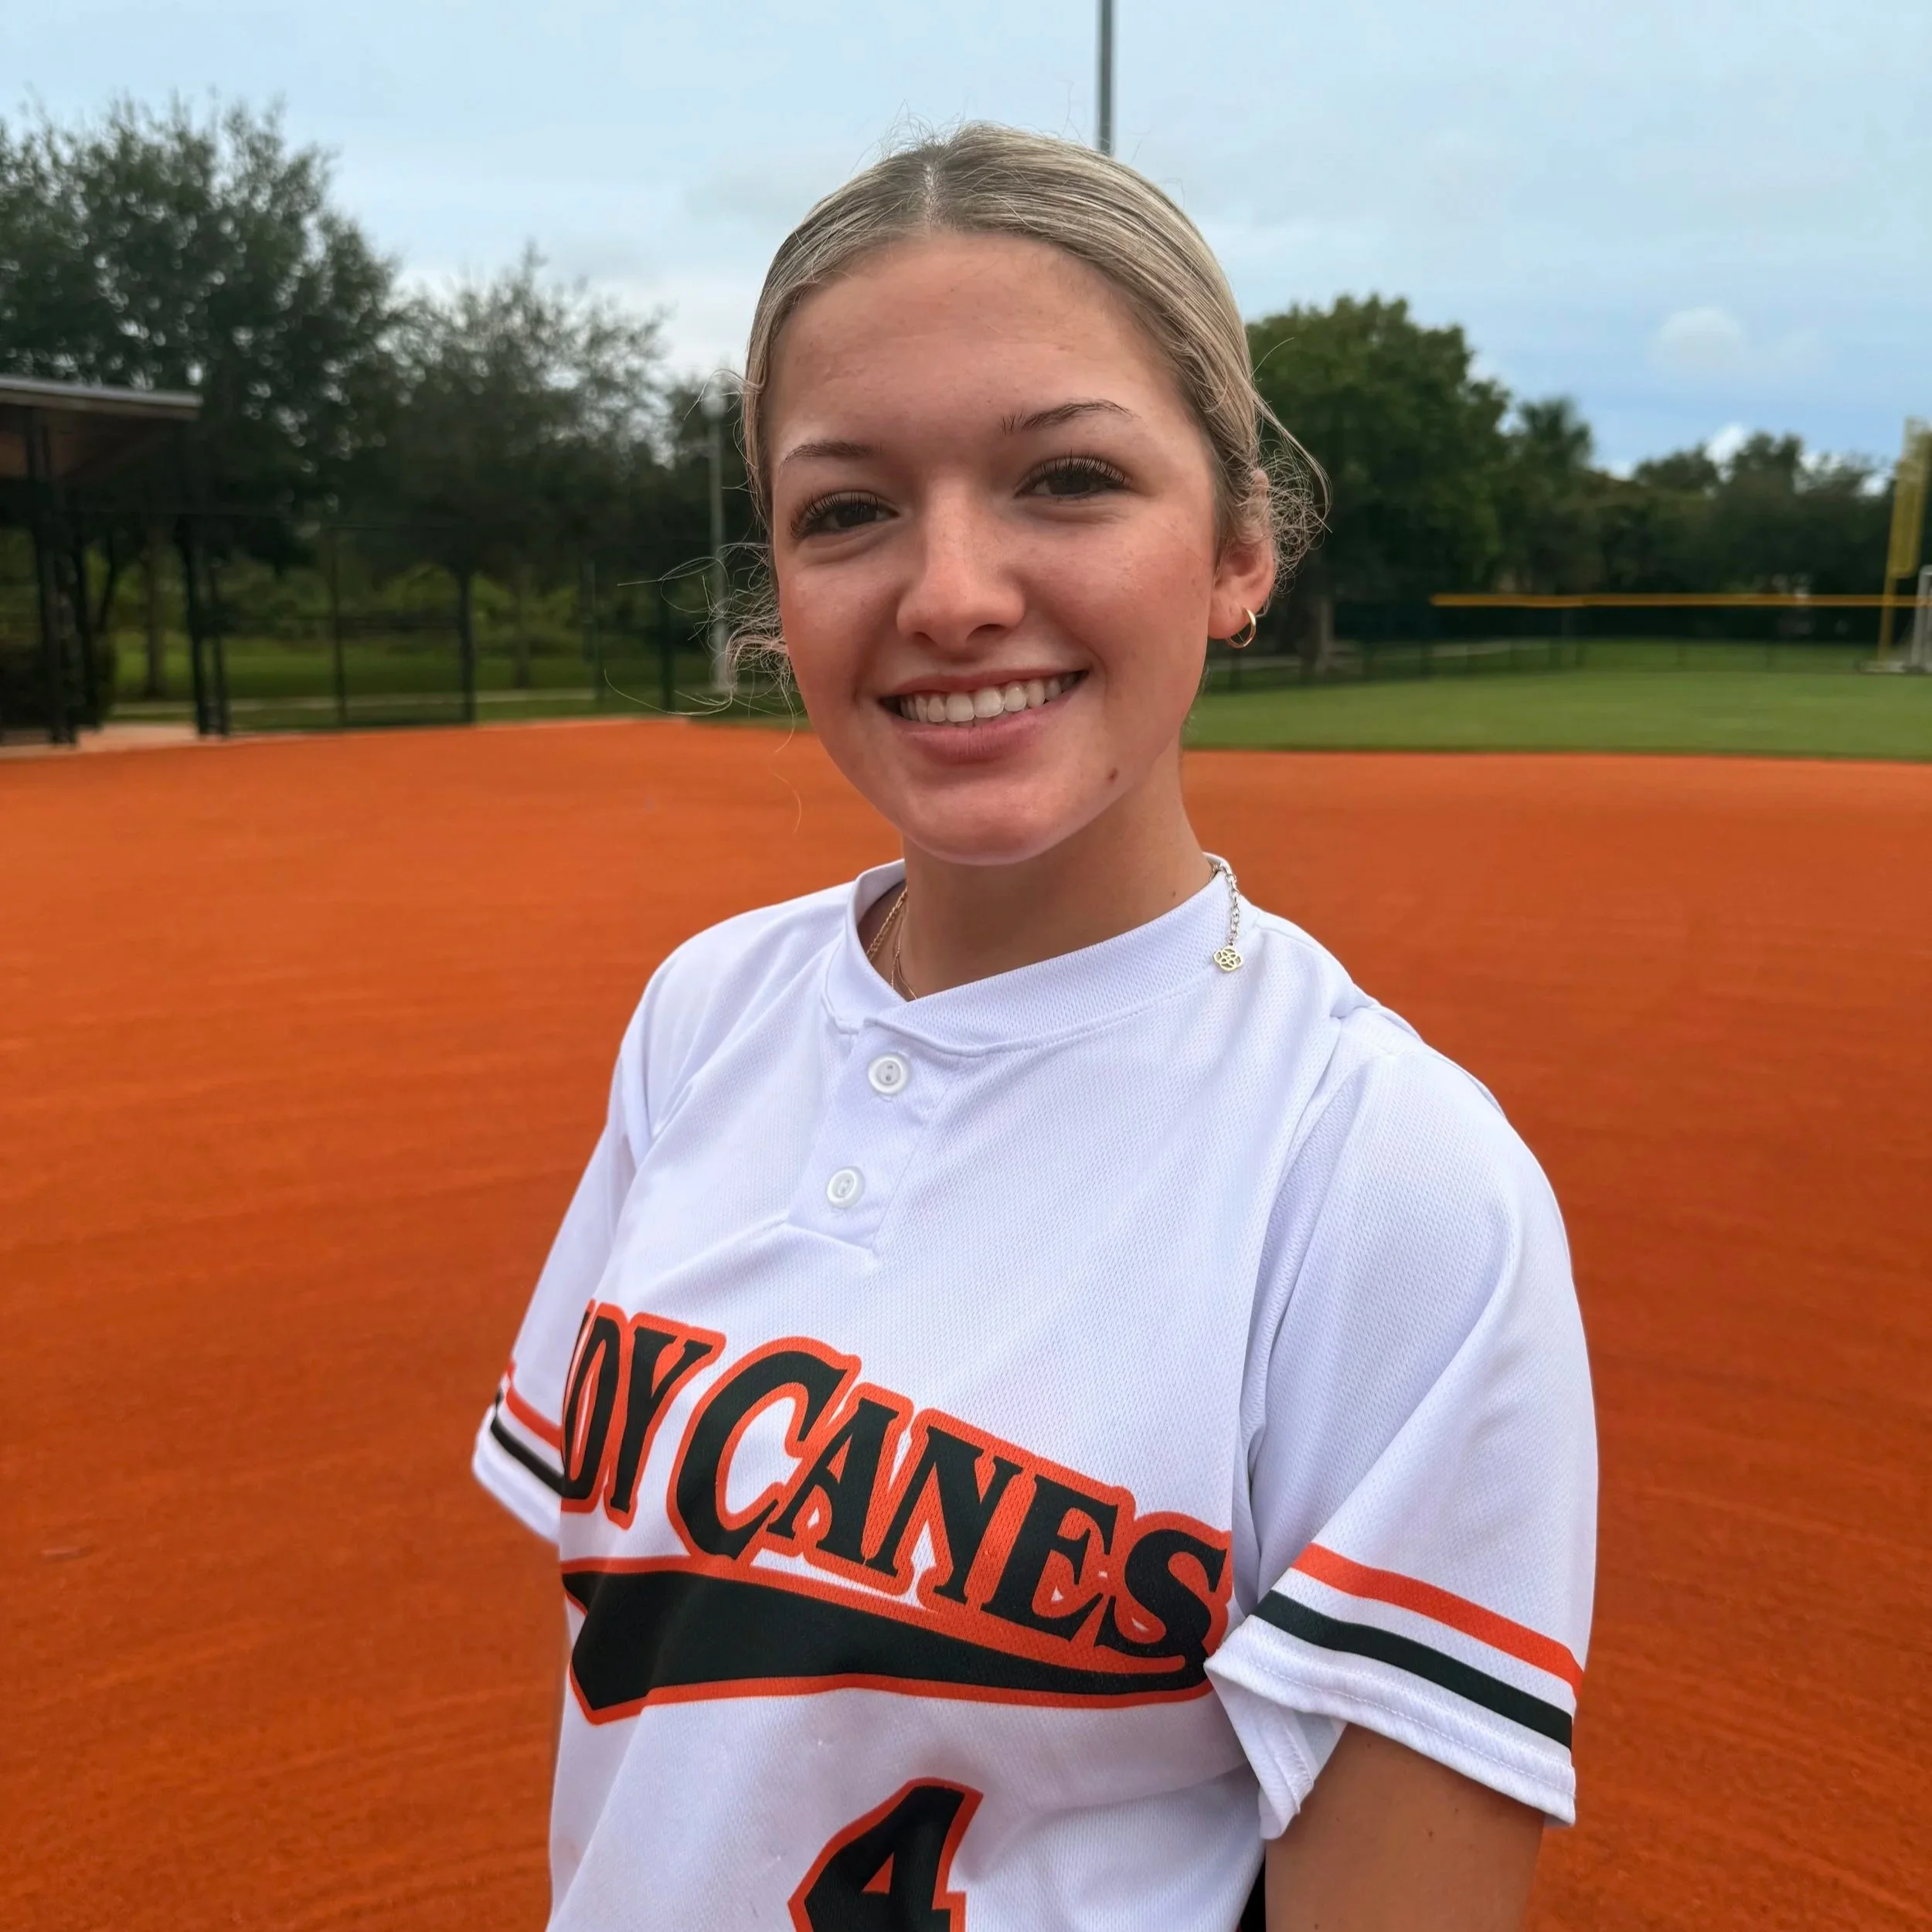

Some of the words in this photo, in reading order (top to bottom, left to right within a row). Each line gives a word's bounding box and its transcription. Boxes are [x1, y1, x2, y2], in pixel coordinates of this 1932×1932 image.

[561, 1298, 727, 1530] DY
[666, 1335, 1233, 1672] CANES
[787, 1776, 984, 1932] 4
